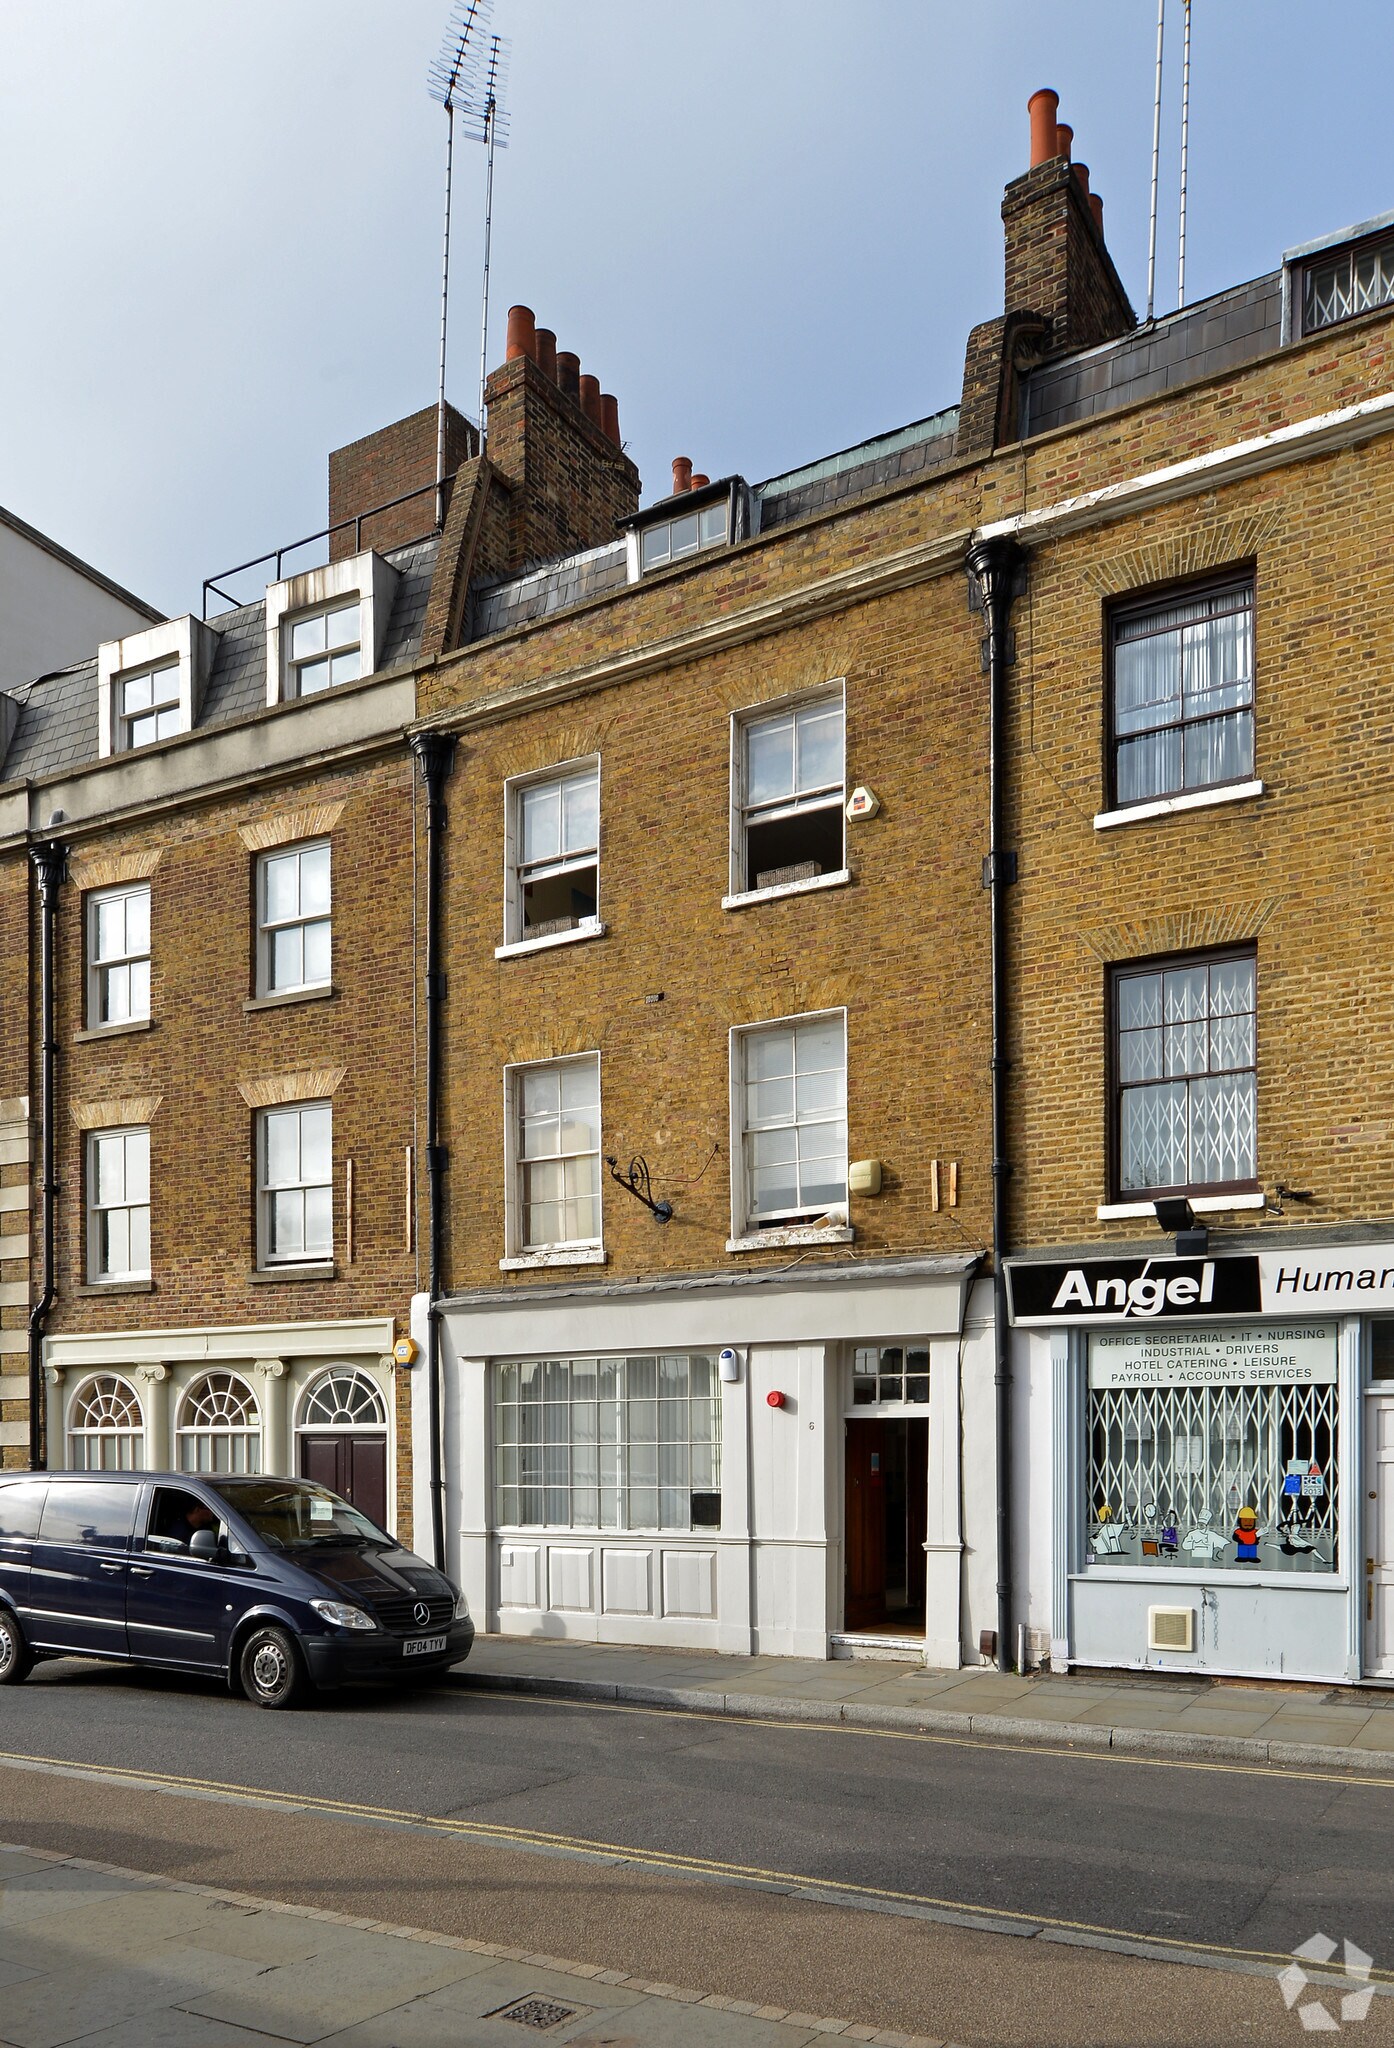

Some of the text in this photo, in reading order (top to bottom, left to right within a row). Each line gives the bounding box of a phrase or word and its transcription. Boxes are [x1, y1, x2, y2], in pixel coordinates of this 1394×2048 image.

[1052, 1262, 1215, 1316] Angel
[1099, 1329, 1326, 1347] OFFICE SECRETARIAL IT NURSING
[1141, 1344, 1279, 1357] INDUSTRIAL DRIVERS
[1125, 1356, 1297, 1370] HOTEL CATERING LEISURE
[1111, 1368, 1312, 1382] PAYROLL ACCOUNTS SERVICES
[808, 1421, 815, 1431] 6
[406, 1638, 444, 1654] DF04 TYV
